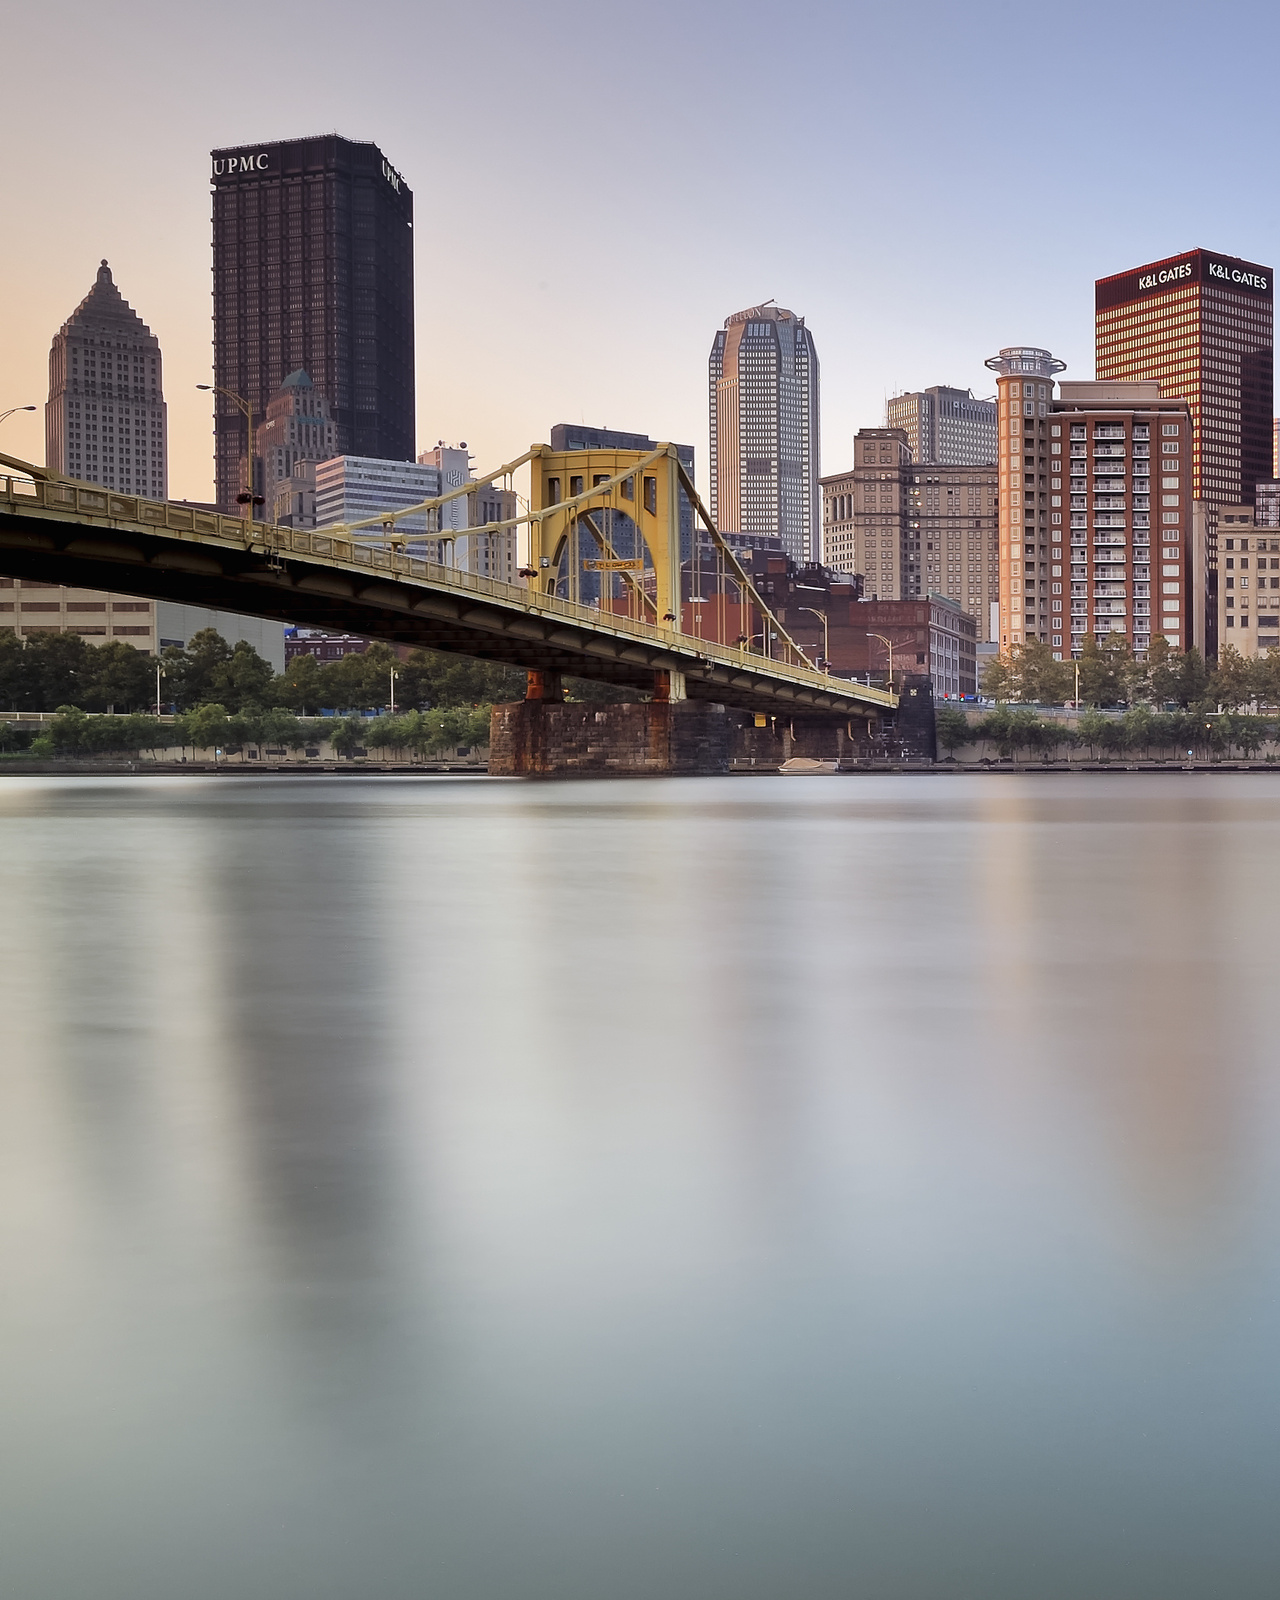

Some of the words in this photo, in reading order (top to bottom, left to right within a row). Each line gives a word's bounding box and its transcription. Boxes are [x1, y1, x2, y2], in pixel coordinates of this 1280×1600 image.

[213, 153, 269, 175] UPMC
[382, 160, 401, 195] UPMC
[1139, 273, 1158, 290] K&L
[1158, 263, 1192, 284] GATES
[1209, 263, 1230, 280] K&L
[1231, 269, 1267, 290] GATES
